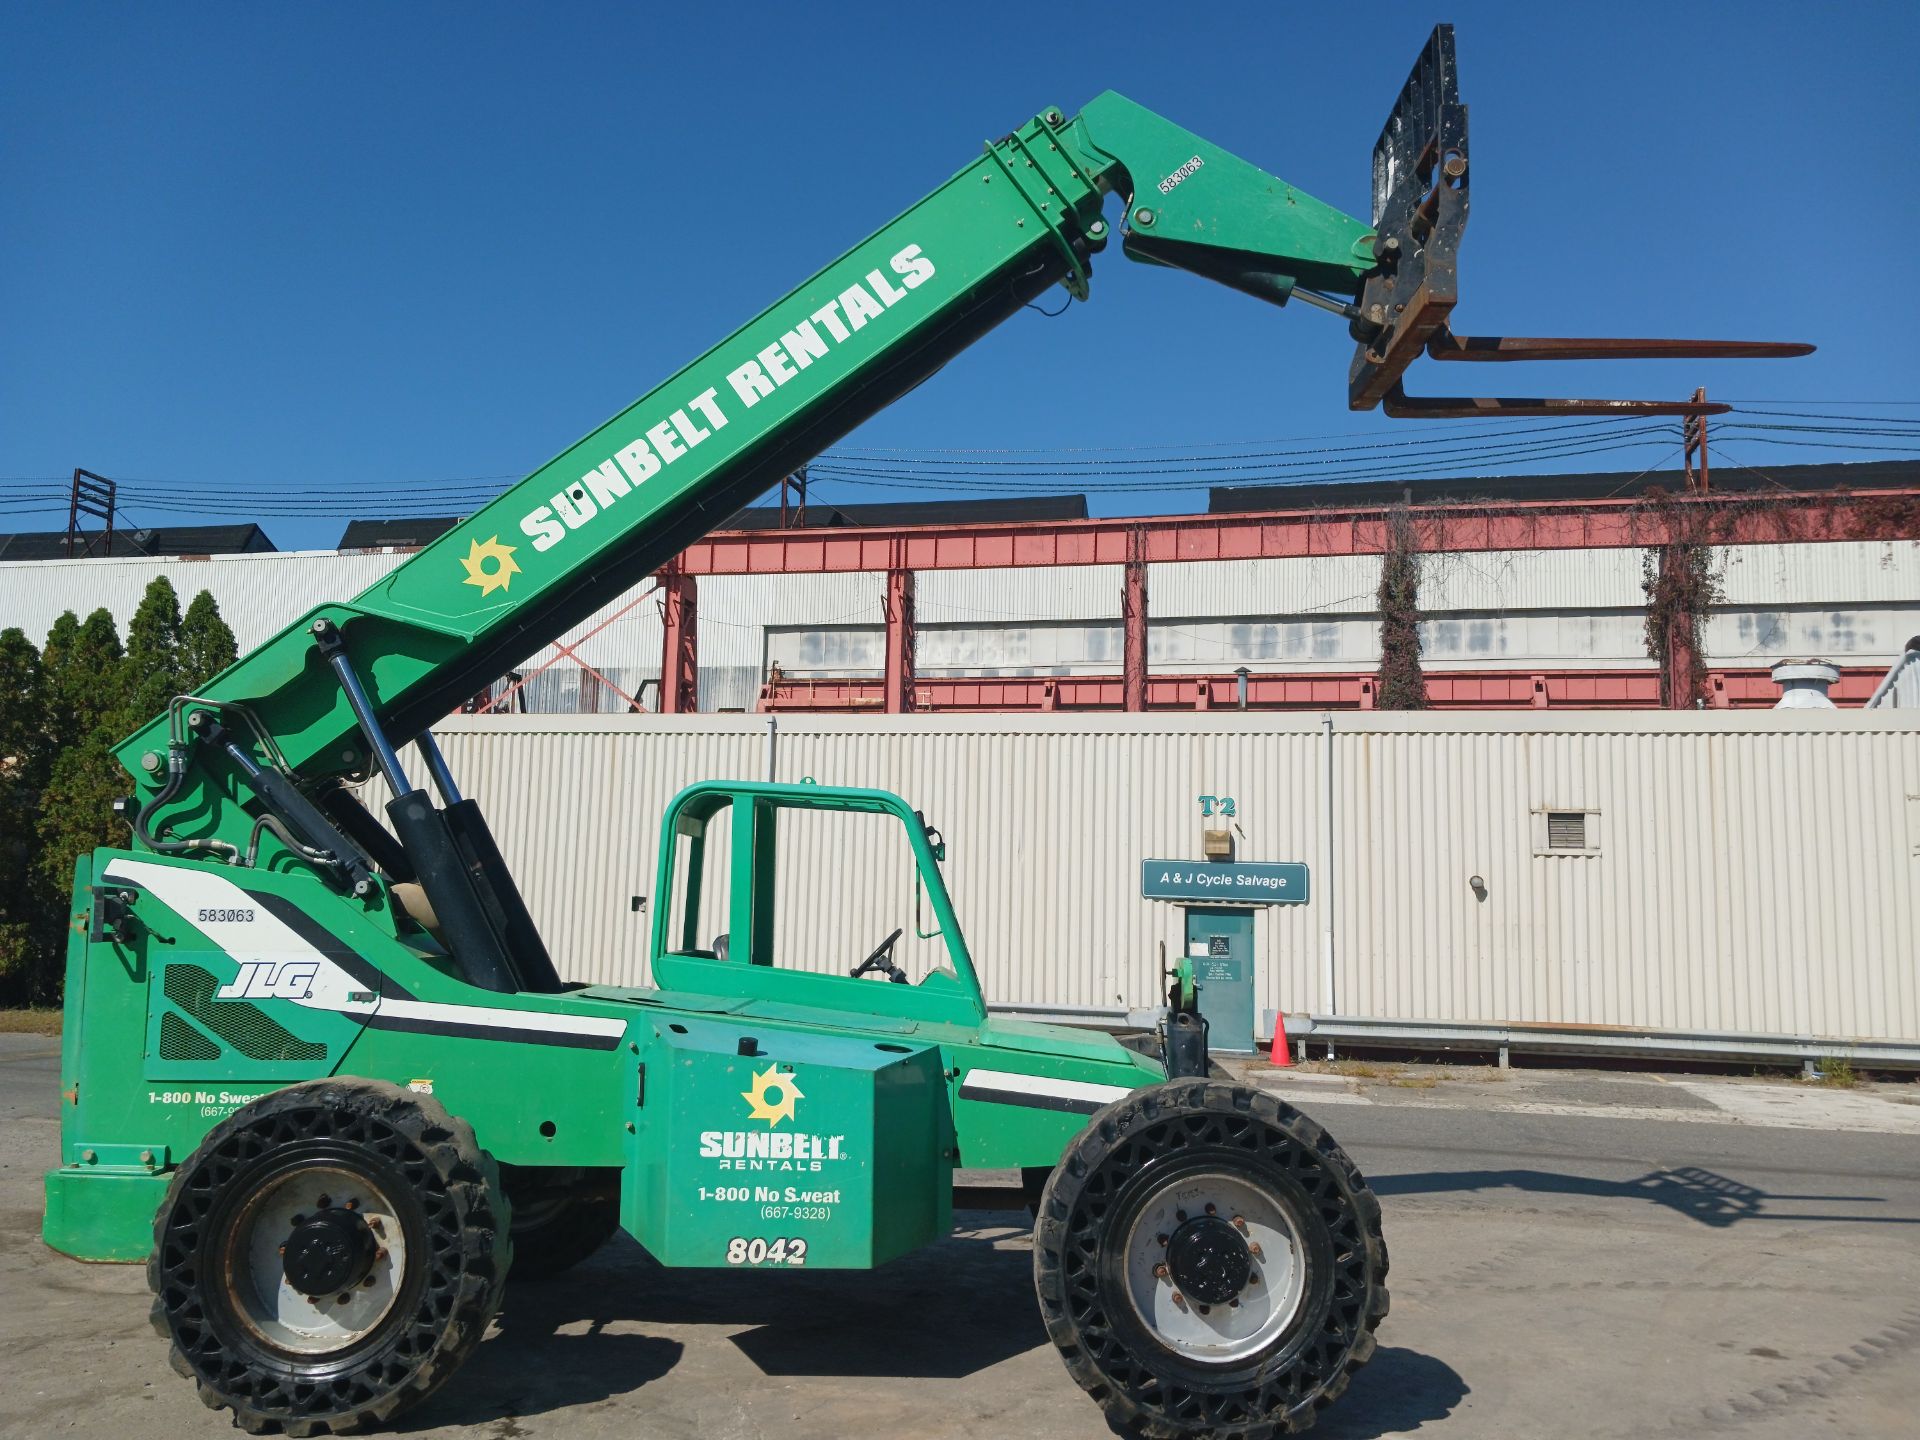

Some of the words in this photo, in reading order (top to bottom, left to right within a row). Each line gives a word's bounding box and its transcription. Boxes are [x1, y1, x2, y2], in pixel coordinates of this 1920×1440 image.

[1159, 157, 1203, 193] 583063
[519, 387, 729, 553] SUNBELT
[726, 243, 936, 408] RENTALS
[1198, 795, 1236, 817] T2
[1160, 872, 1170, 883] A
[1173, 872, 1182, 884] &
[1185, 873, 1193, 884] J
[1196, 873, 1232, 887] Cycle
[1236, 874, 1287, 889] Salvage
[198, 909, 255, 922] 583063
[216, 962, 320, 999] JLG
[148, 1091, 191, 1104] 1-800
[195, 1091, 216, 1104] No
[700, 1131, 844, 1160] SUNBELT
[719, 1159, 822, 1172] RENTALS
[698, 1187, 749, 1201] 1-800
[754, 1186, 780, 1202] No
[784, 1186, 841, 1204] Sweat
[760, 1205, 831, 1221] (667-9328)
[726, 1236, 807, 1265] 8042
